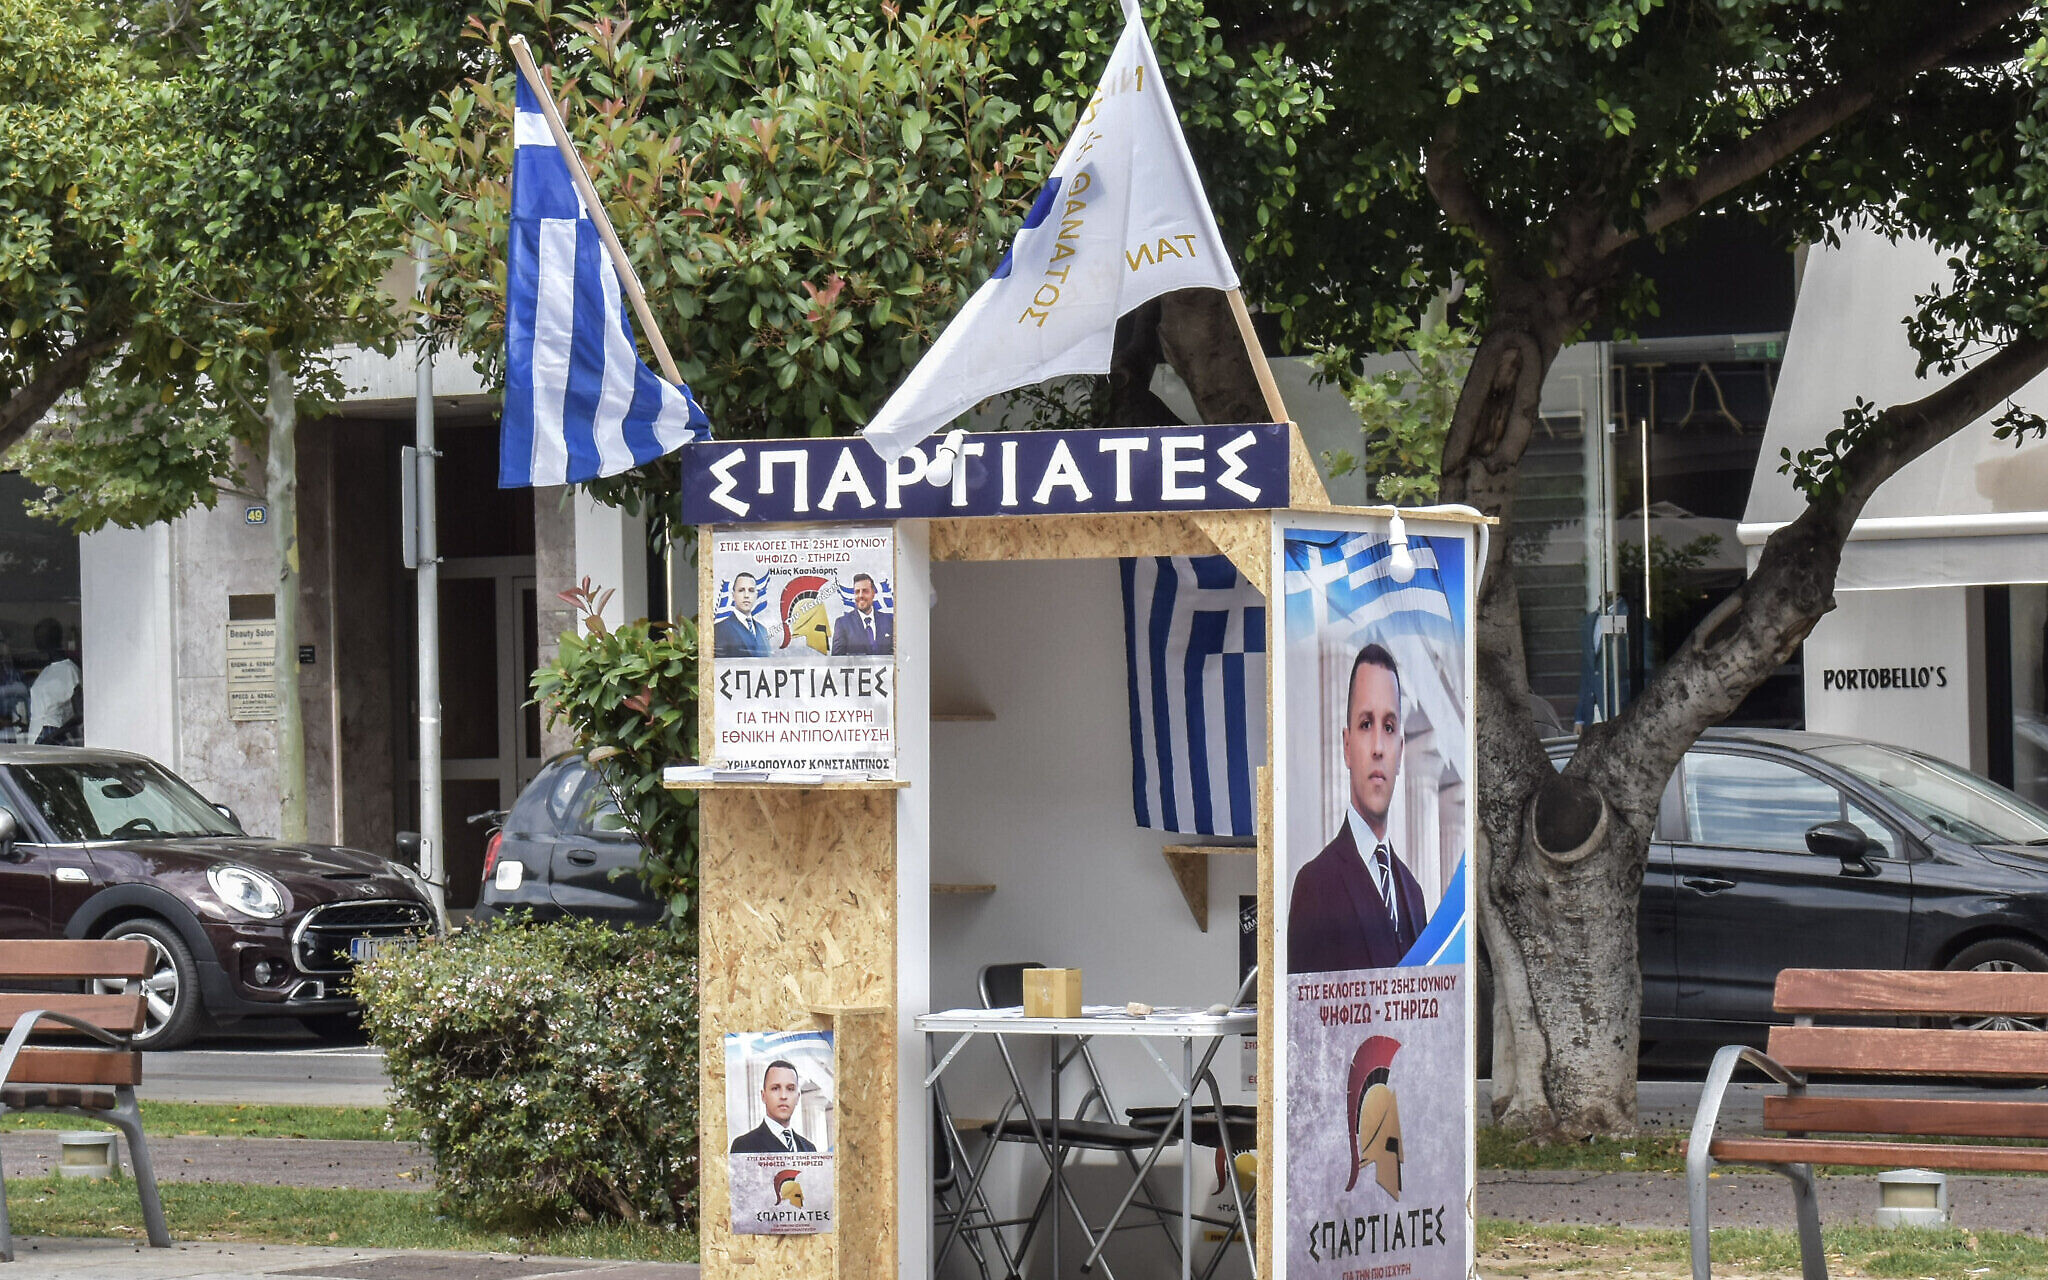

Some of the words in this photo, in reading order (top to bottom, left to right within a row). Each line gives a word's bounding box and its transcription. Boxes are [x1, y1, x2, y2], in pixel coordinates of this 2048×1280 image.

[1018, 172, 1091, 328] ΘΑΝΑΤΟΣ
[708, 430, 1262, 517] ΣΠΑΡΤΙΑΤΕΣ
[247, 510, 262, 521] 49
[720, 541, 740, 551] ΣΤΙΣ
[743, 541, 787, 551] ΕΚΛΟΓΕΣ
[790, 540, 809, 550] ΤΗΣ
[812, 539, 839, 550] 25ΗΣ
[843, 538, 887, 548] ΙΟΥΝΙΟΥ
[755, 553, 798, 564] ΨΗΦΙΖΩ
[807, 552, 851, 563] ΣΤΗΡΙΖΩ
[230, 630, 254, 639] Beauty
[256, 629, 275, 637] Salon
[719, 666, 889, 701] ΣΠΑΡΤΙΑΤΕΣ
[1823, 666, 1947, 690] PORTOBELLO'S
[737, 712, 757, 724] ΓΙΑ
[762, 711, 790, 724] ΤΗΝ
[795, 710, 820, 723] ΠΙΟ
[825, 710, 873, 723] ΙΣΧΥΡΗ
[722, 730, 775, 743] ΕΘΝΙΚΗ
[780, 729, 889, 743] ΑΝΤΙΠΟΛΙΤΕΥΣΗ
[724, 759, 807, 770] ΥΡΙΑΚΟΠΟΥΛΟΣ
[809, 758, 890, 770] ΚΩΝΣΤΑΝΤΙΝΟΣ
[1297, 984, 1320, 1001] ΣΤΙΣ
[1322, 981, 1367, 999] ΕΚΛΟΓΕΣ
[1369, 979, 1388, 996] ΤΗΣ
[1391, 978, 1415, 994] 25ΗΣ
[1418, 975, 1457, 993] ΙΟΥΝΙΟΥ
[1319, 1003, 1372, 1027] ΨΗΦΙΖΩ
[1384, 998, 1439, 1022] ΣΤΗΡΙΖΩ
[756, 1210, 830, 1222] ΣΠΑΡΤΙΑΤΕΣ
[1309, 1204, 1447, 1263] ΣΠΑΡΤΙΑΤΕΣ
[1385, 1263, 1411, 1278] ΙΣΧΥΡΗ
